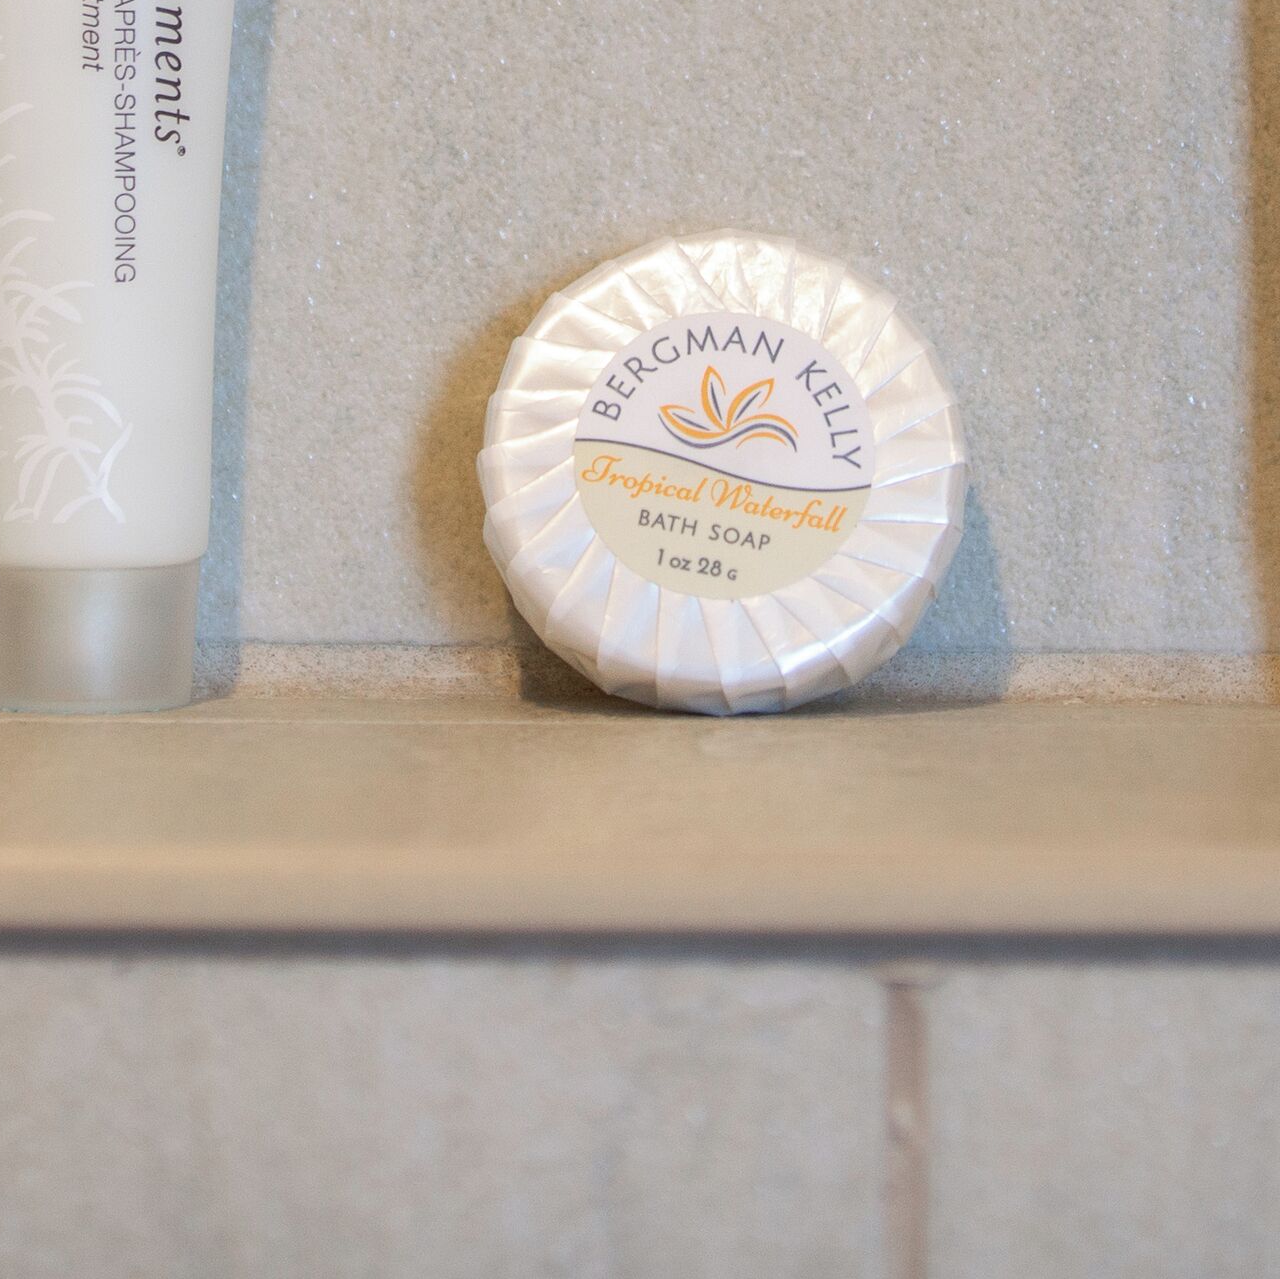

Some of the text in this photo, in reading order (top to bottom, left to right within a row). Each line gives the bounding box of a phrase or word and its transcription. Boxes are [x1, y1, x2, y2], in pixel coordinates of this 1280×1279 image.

[592, 325, 862, 469] BERGMAN KELLY
[582, 454, 847, 533] Tropical Waterfall
[638, 510, 771, 550] BATH SOAP
[657, 548, 664, 566] 1
[670, 557, 691, 571] oz
[698, 557, 721, 577] 28
